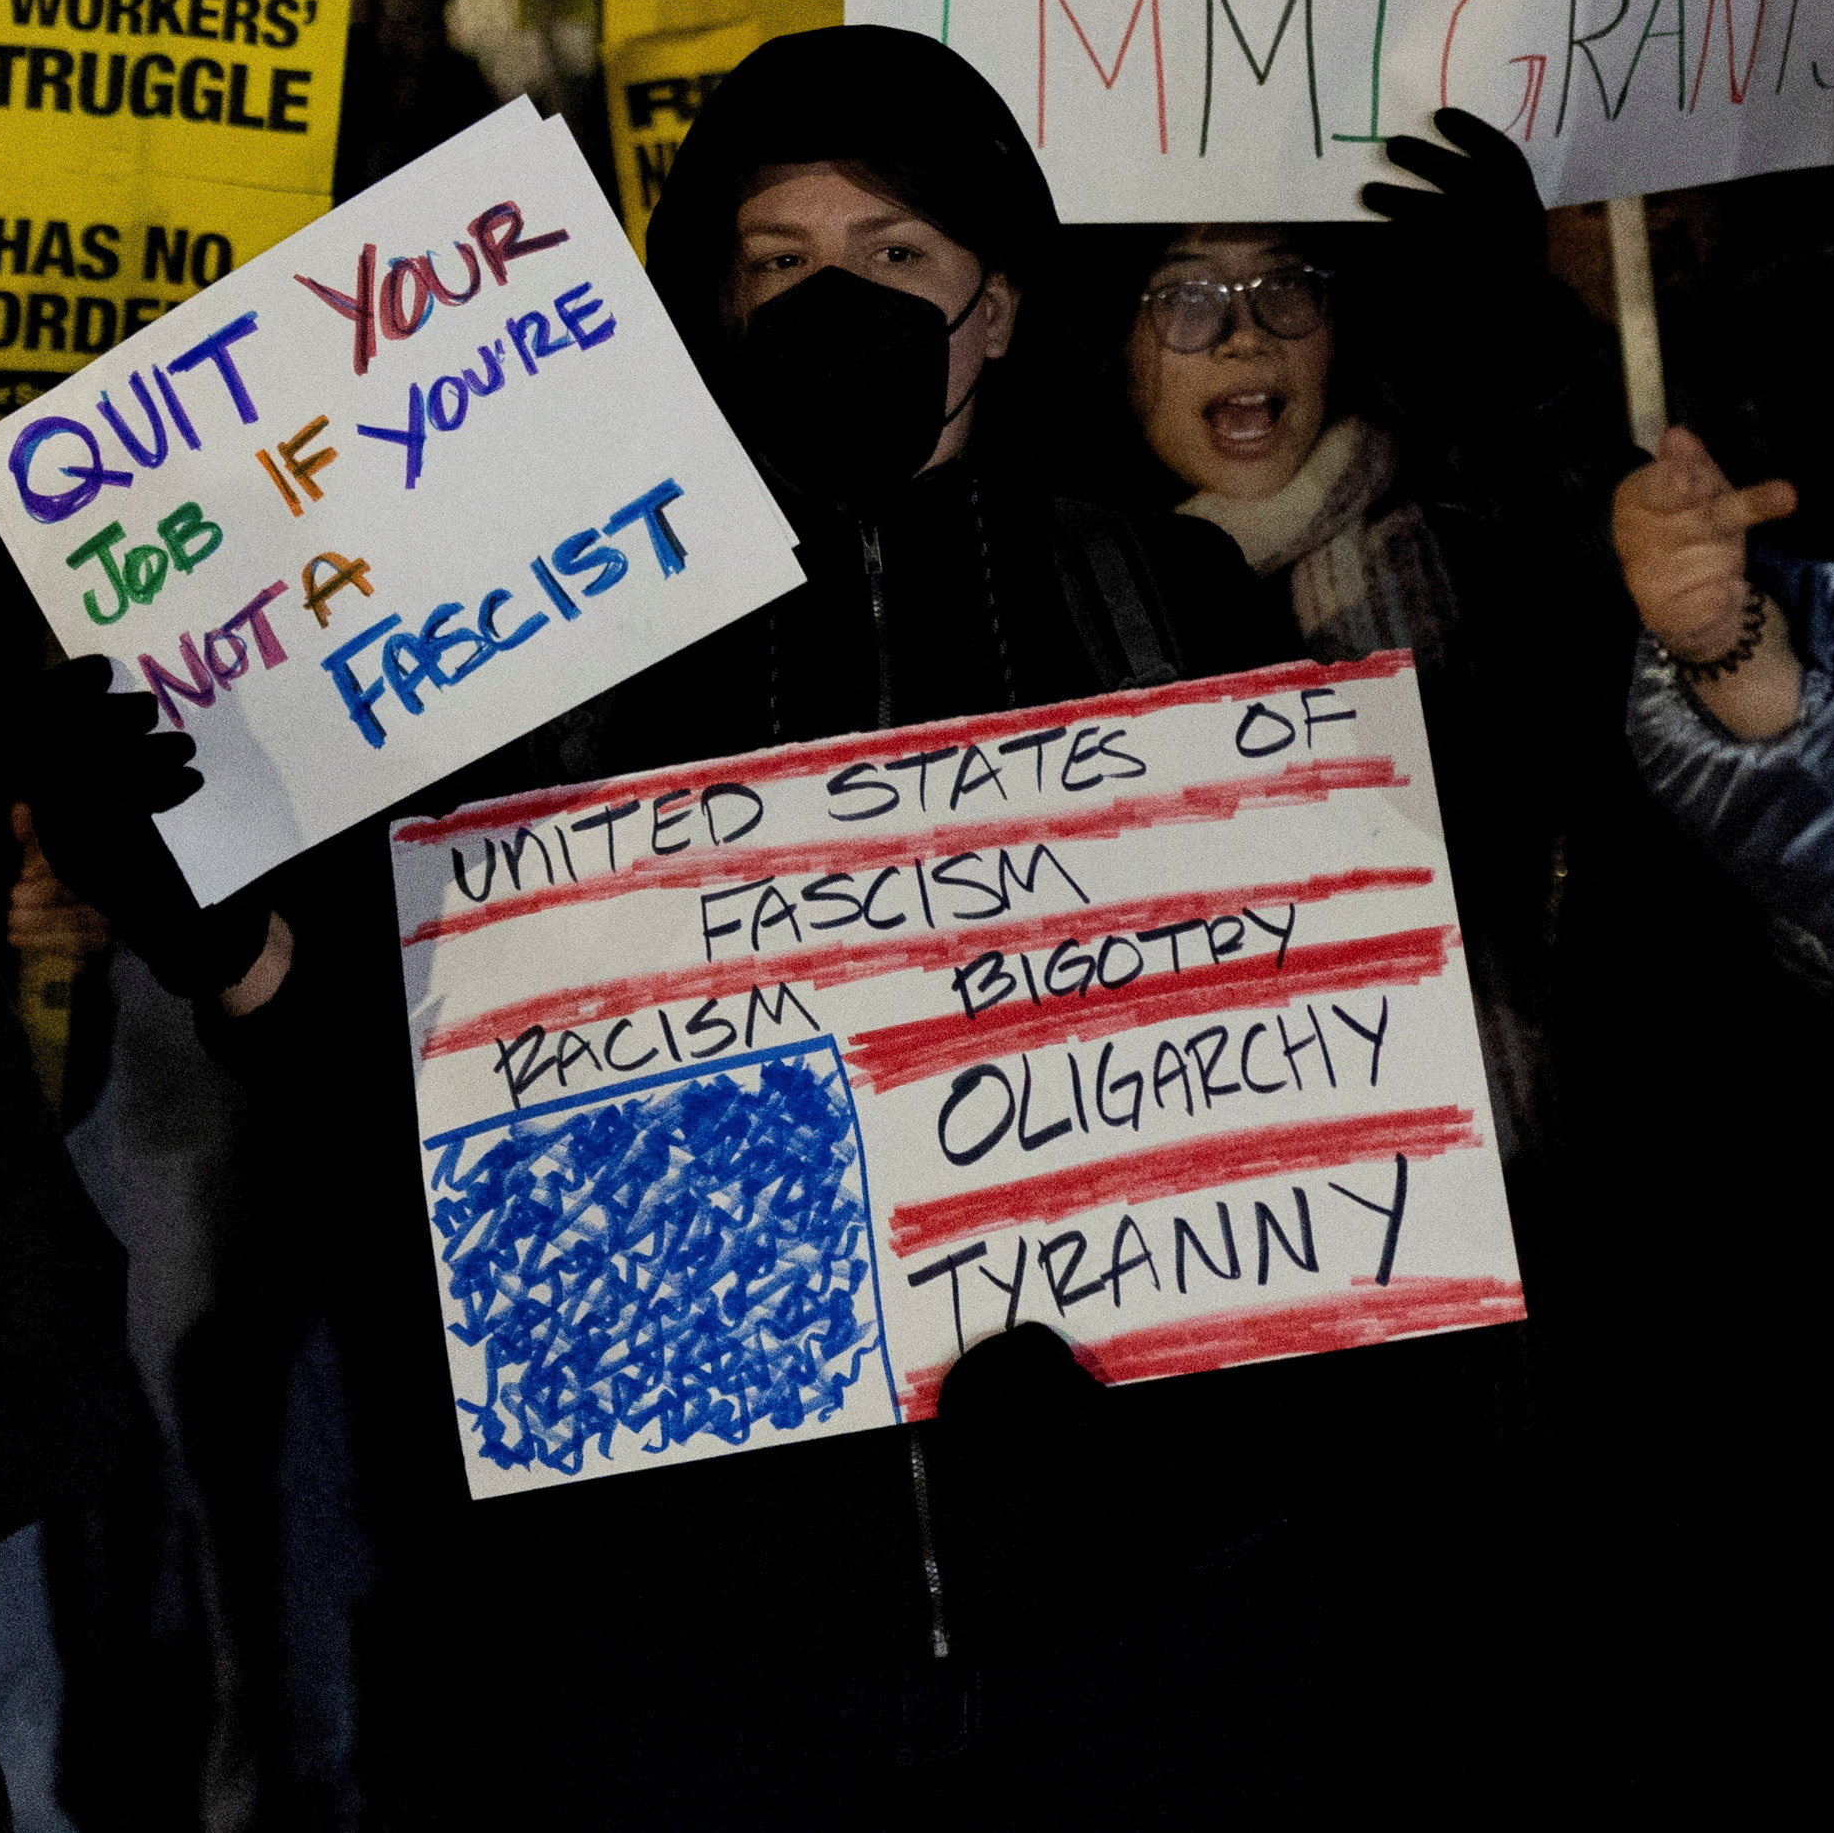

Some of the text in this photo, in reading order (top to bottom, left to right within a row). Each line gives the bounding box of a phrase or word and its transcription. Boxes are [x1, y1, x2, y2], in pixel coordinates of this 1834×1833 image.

[142, 223, 234, 288] NO
[7, 310, 261, 524] QUIT
[293, 200, 571, 376] YOUR
[66, 501, 224, 626] JOB
[255, 414, 338, 517] IF
[356, 280, 618, 490] YOU'RE
[137, 551, 372, 730] NOT A
[321, 478, 686, 750] FASCIST
[451, 686, 1360, 907] UNITED STATES OF
[494, 902, 1298, 1110] RACISM BIGOTRY
[700, 843, 1091, 964] FASCISM
[935, 996, 1390, 1168] OLIGARCHY
[907, 1152, 1410, 1356] TYRANNY
